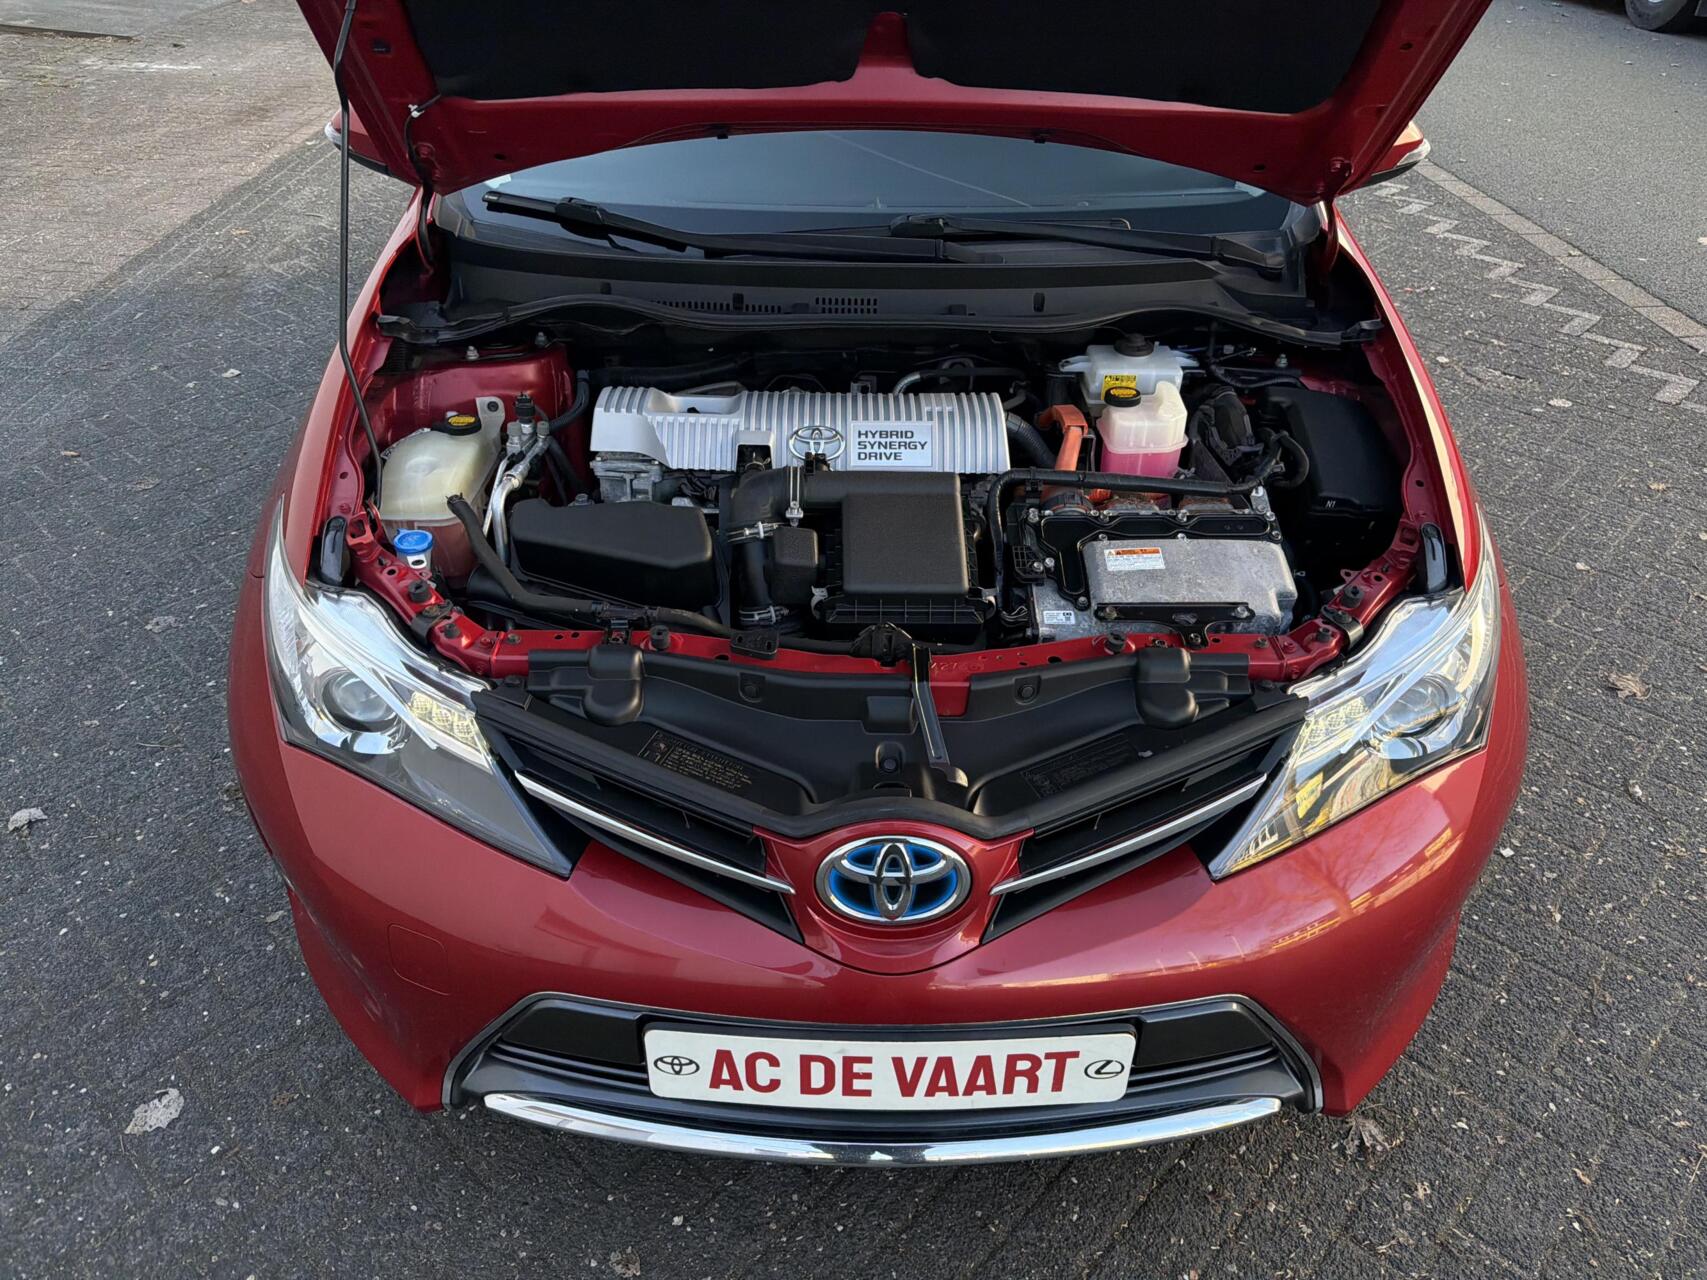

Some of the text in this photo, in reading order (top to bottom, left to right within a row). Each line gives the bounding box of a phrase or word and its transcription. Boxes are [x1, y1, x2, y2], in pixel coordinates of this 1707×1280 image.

[857, 430, 914, 439] HYBRID
[857, 441, 928, 450] SYNERGY
[857, 452, 903, 461] DRIVE
[709, 1048, 1081, 1098] AC DE VAART
